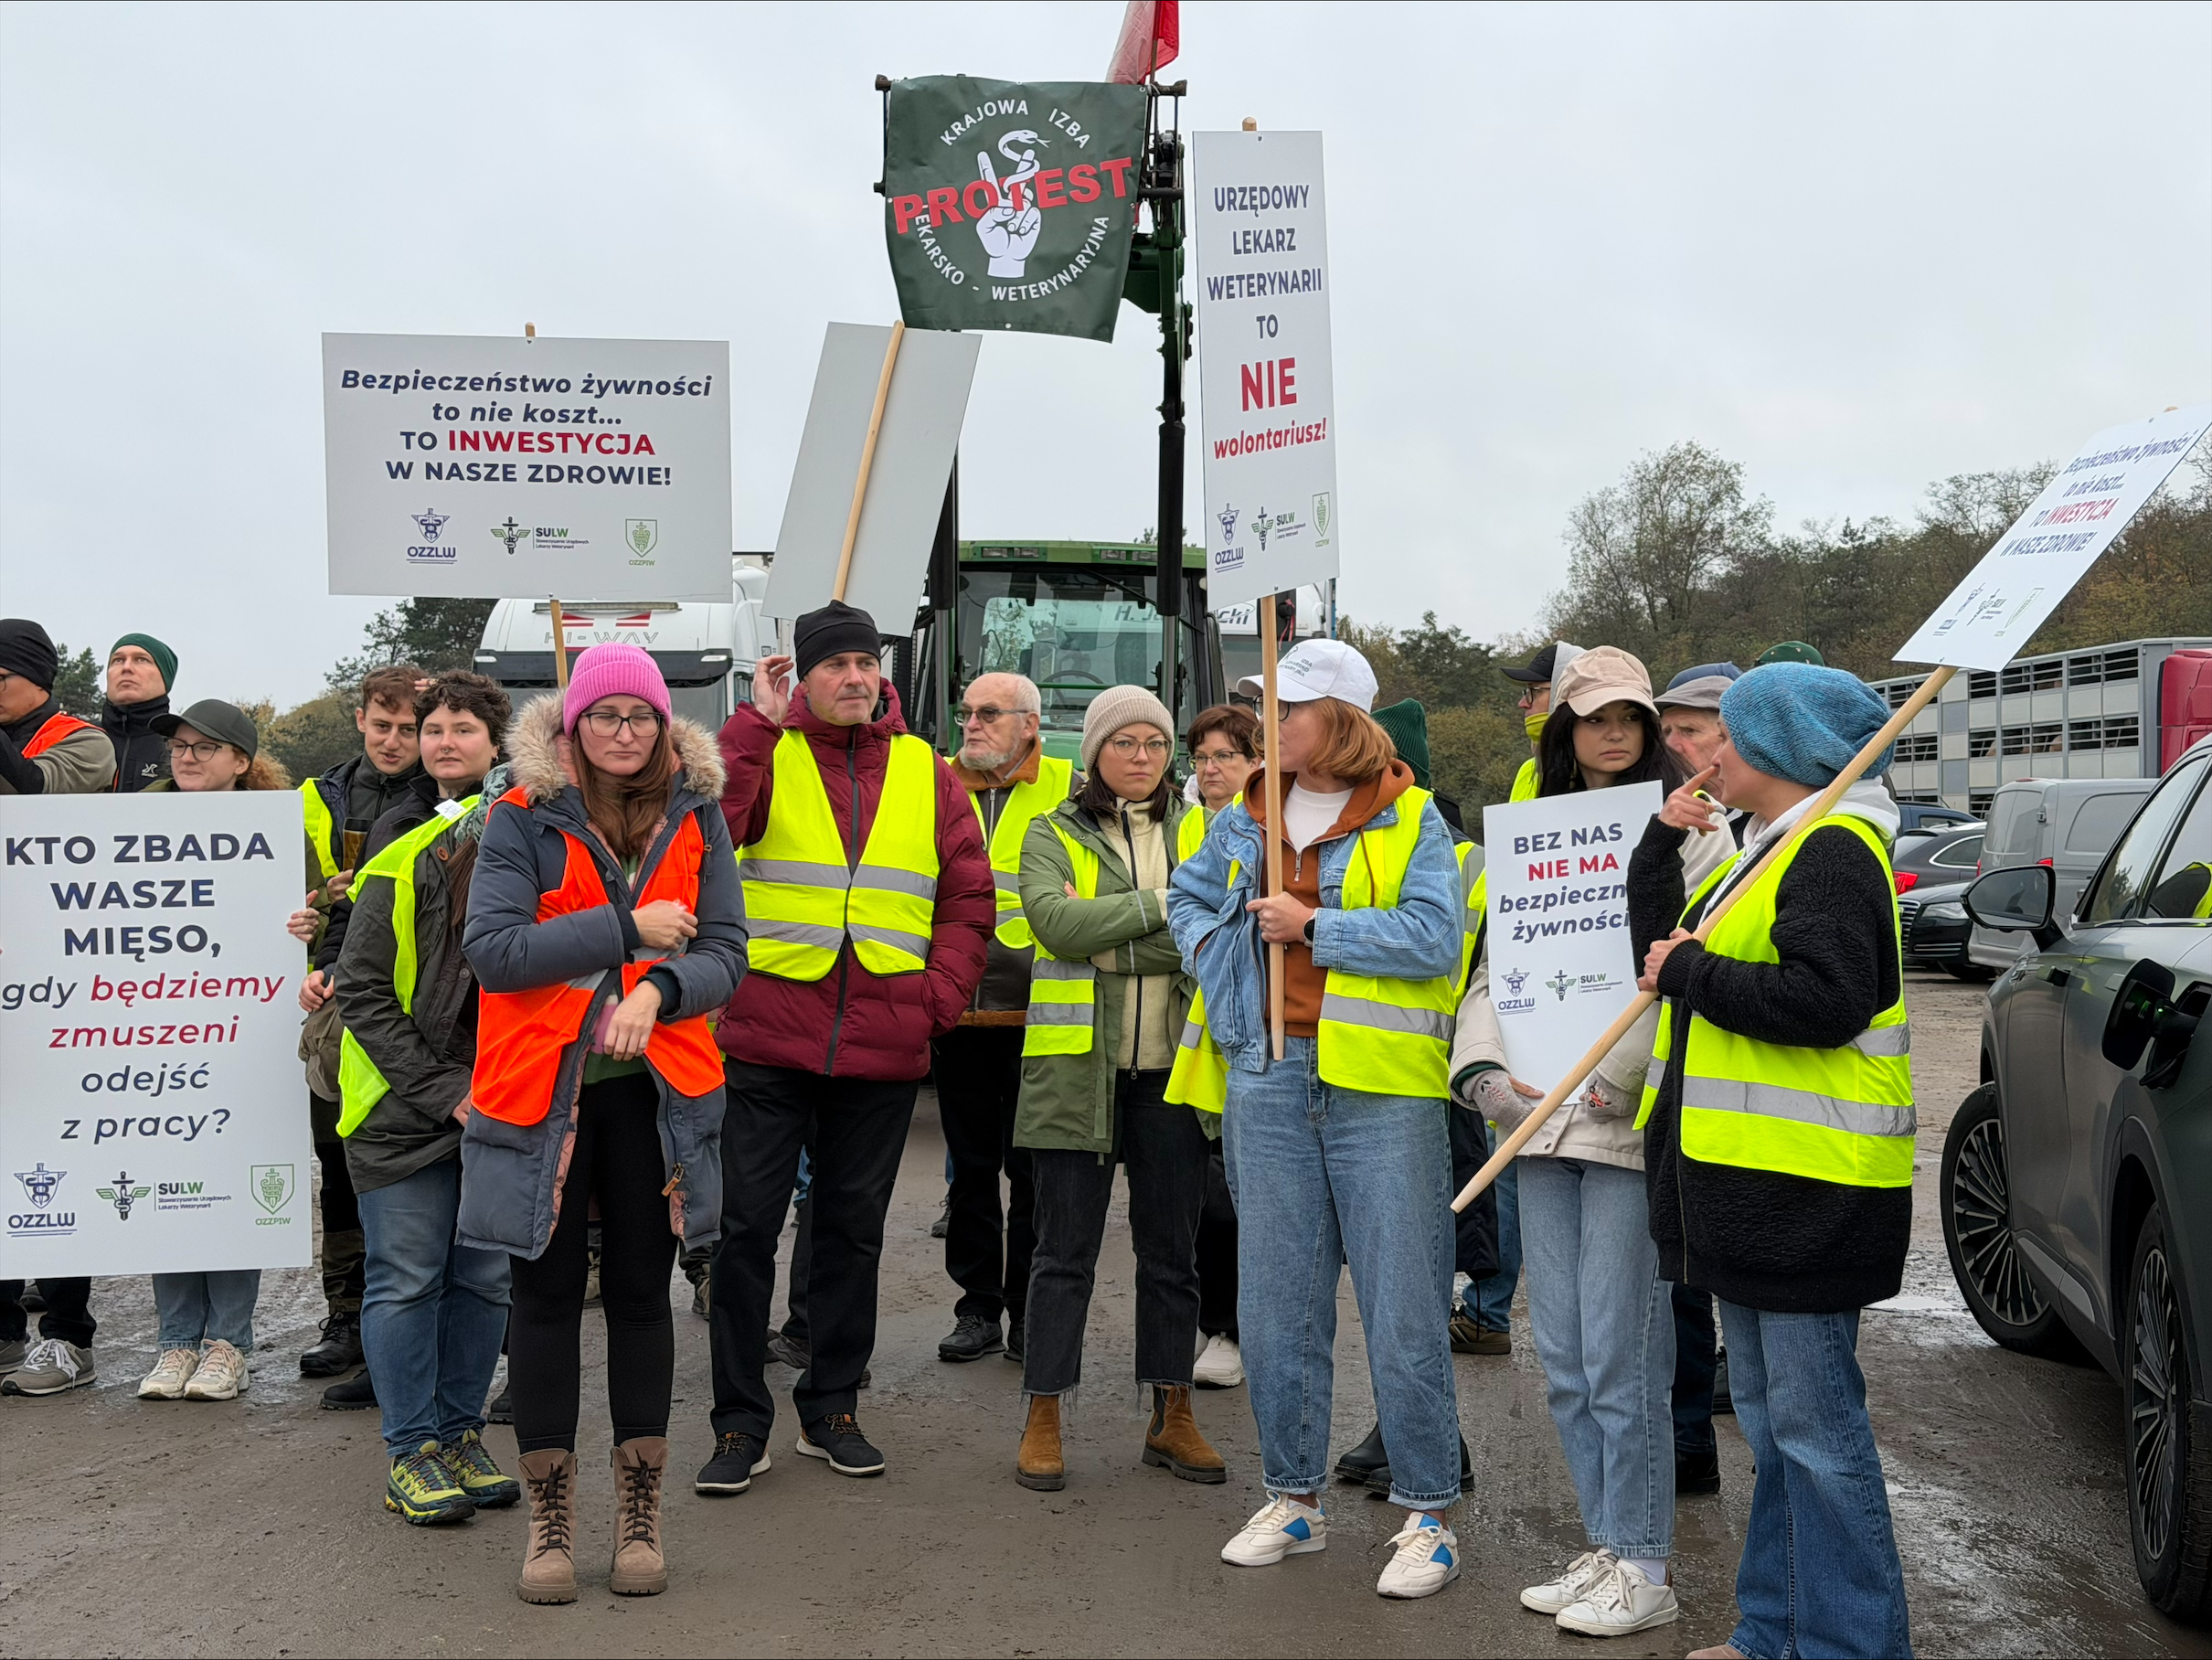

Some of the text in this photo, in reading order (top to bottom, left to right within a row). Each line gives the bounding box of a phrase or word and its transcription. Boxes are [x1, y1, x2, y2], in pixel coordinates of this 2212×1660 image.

[940, 99, 1091, 149] KRAJOWA IZBA
[893, 156, 1133, 235] PROTEST
[1214, 184, 1310, 218] URZĘDOWY
[915, 204, 965, 285] EKARSKO
[992, 216, 1110, 302] WETERYNARYJNA
[1232, 229, 1296, 255] LEKARZ
[1207, 268, 1323, 301] WETERYNARII
[1257, 314, 1279, 339] TO
[341, 369, 713, 398] Bezpieczeństwo żywności
[1241, 356, 1297, 412] NIE
[432, 400, 622, 425] to nie koszt...
[400, 431, 655, 455] TO INWESTYCJA
[1214, 418, 1327, 460] wolontariusz!
[385, 462, 672, 486] W NASZE ZDROWIE!
[1276, 512, 1295, 526] SULW
[2028, 498, 2120, 528] TO INWESTYCJA
[536, 527, 569, 537] SULW
[407, 546, 457, 559] OZZLW
[1215, 547, 1244, 565] OZZLW
[1218, 608, 1250, 624] cki
[5, 833, 274, 865] KTO ZBADA
[1514, 823, 1623, 855] BEZ NAS
[1528, 853, 1619, 881] NIE MA
[51, 879, 216, 910] WASZE
[1499, 883, 1626, 914] bezpieczn
[1512, 908, 1630, 943] żywności
[64, 925, 221, 962] MIĘSO,
[2, 972, 286, 1010] gdy będziemy
[1580, 974, 1606, 984] SULW
[1498, 998, 1536, 1010] OZZLW
[48, 1016, 239, 1048] zmuszeni
[81, 1062, 211, 1097] odejść
[61, 1109, 231, 1145] z pracy?
[158, 1182, 204, 1195] SULW
[8, 1211, 75, 1229] OZZLW
[255, 1218, 292, 1226] OZZPIW
